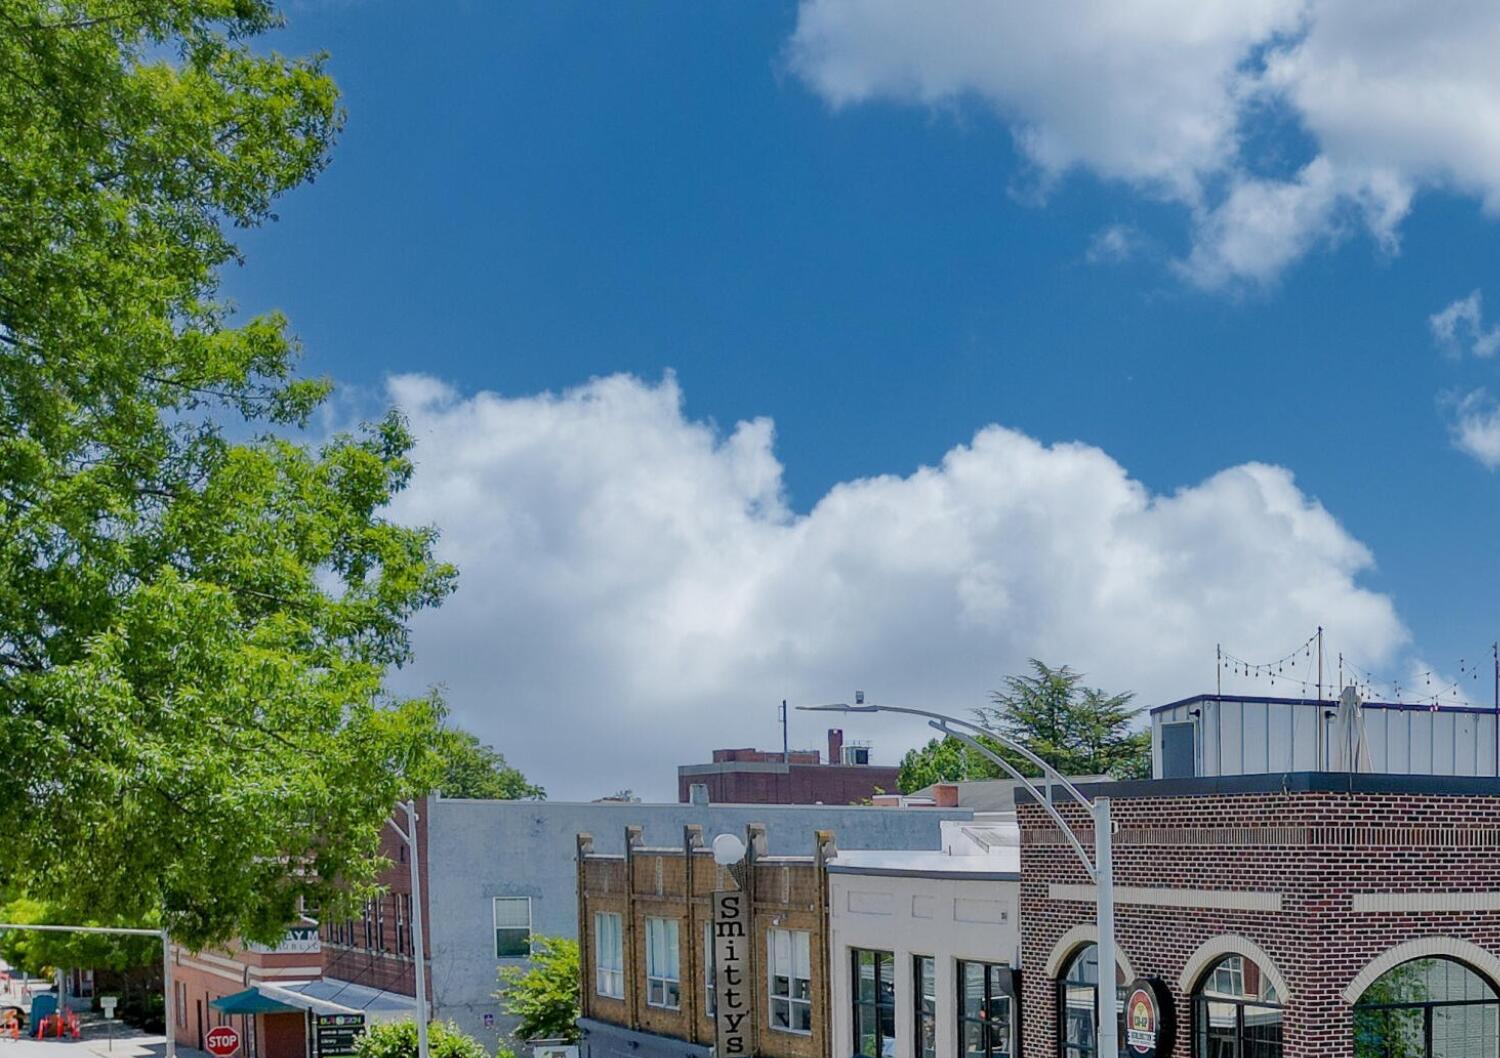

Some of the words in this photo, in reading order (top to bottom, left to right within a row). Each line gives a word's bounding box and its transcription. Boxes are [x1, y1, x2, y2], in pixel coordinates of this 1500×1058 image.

[281, 930, 304, 941] AY
[716, 897, 750, 1054] Smitty's
[209, 1035, 237, 1048] STOP
